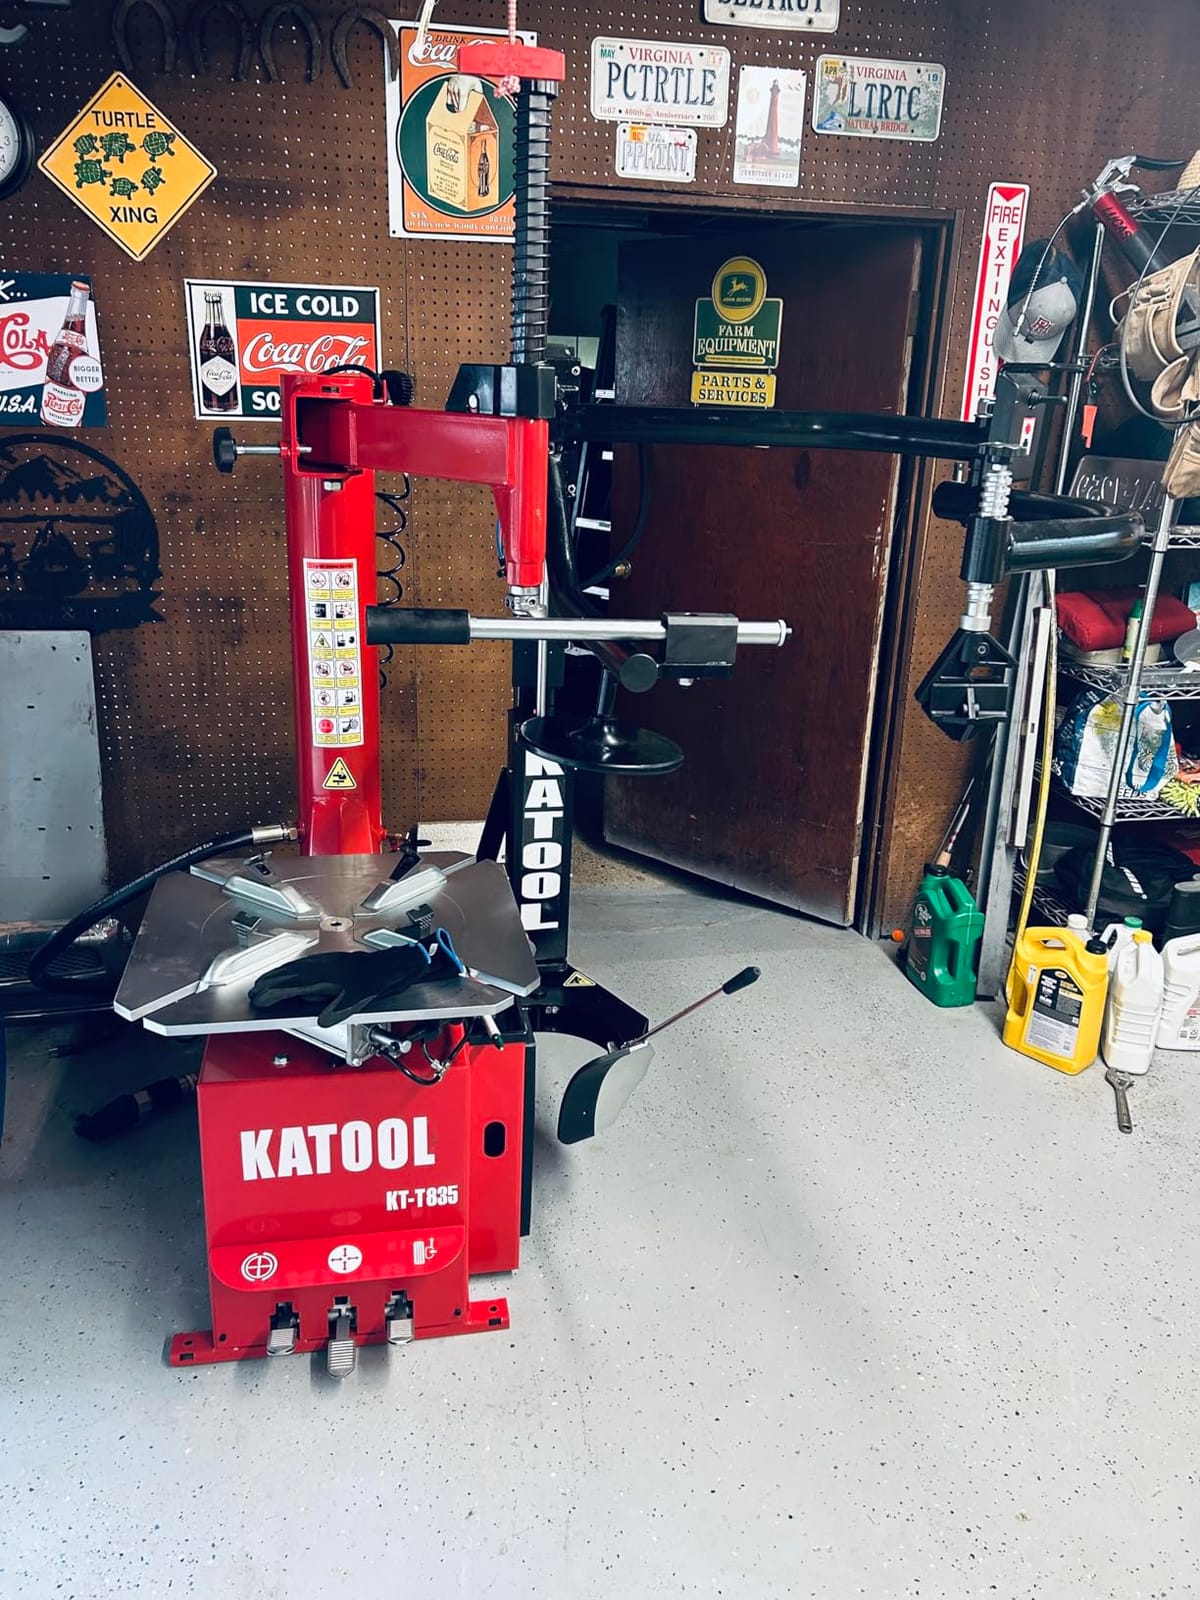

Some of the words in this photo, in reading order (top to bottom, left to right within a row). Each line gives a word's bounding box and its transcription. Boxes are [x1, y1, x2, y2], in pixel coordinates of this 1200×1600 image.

[434, 36, 465, 44] DRINK
[600, 48, 615, 59] MAY
[628, 47, 694, 65] VIRGINIA
[857, 66, 907, 81] VIRGINIA
[927, 73, 939, 82] 19
[606, 62, 717, 107] PCTRTLE
[92, 110, 156, 128] TURTLE
[846, 119, 878, 131] NATURAL
[880, 121, 909, 133] BRIDGE
[110, 206, 158, 224] XING
[409, 211, 428, 220] SIX
[991, 205, 1021, 225] FIRE
[1102, 206, 1133, 241] LUCAS
[250, 293, 288, 315] ICE
[296, 296, 359, 318] COLD
[978, 228, 1009, 397] EXTINGUISH
[718, 325, 754, 338] FARM
[242, 332, 371, 375] Coca-Cola
[697, 338, 775, 359] EQUIPMENT
[73, 365, 99, 373] BIGGER
[702, 375, 751, 389] PARTS
[755, 377, 766, 390] &
[698, 388, 767, 404] SERVICES
[521, 750, 564, 931] KATOOL
[240, 1116, 436, 1181] KATOOL
[385, 1185, 459, 1211] KT-T835
